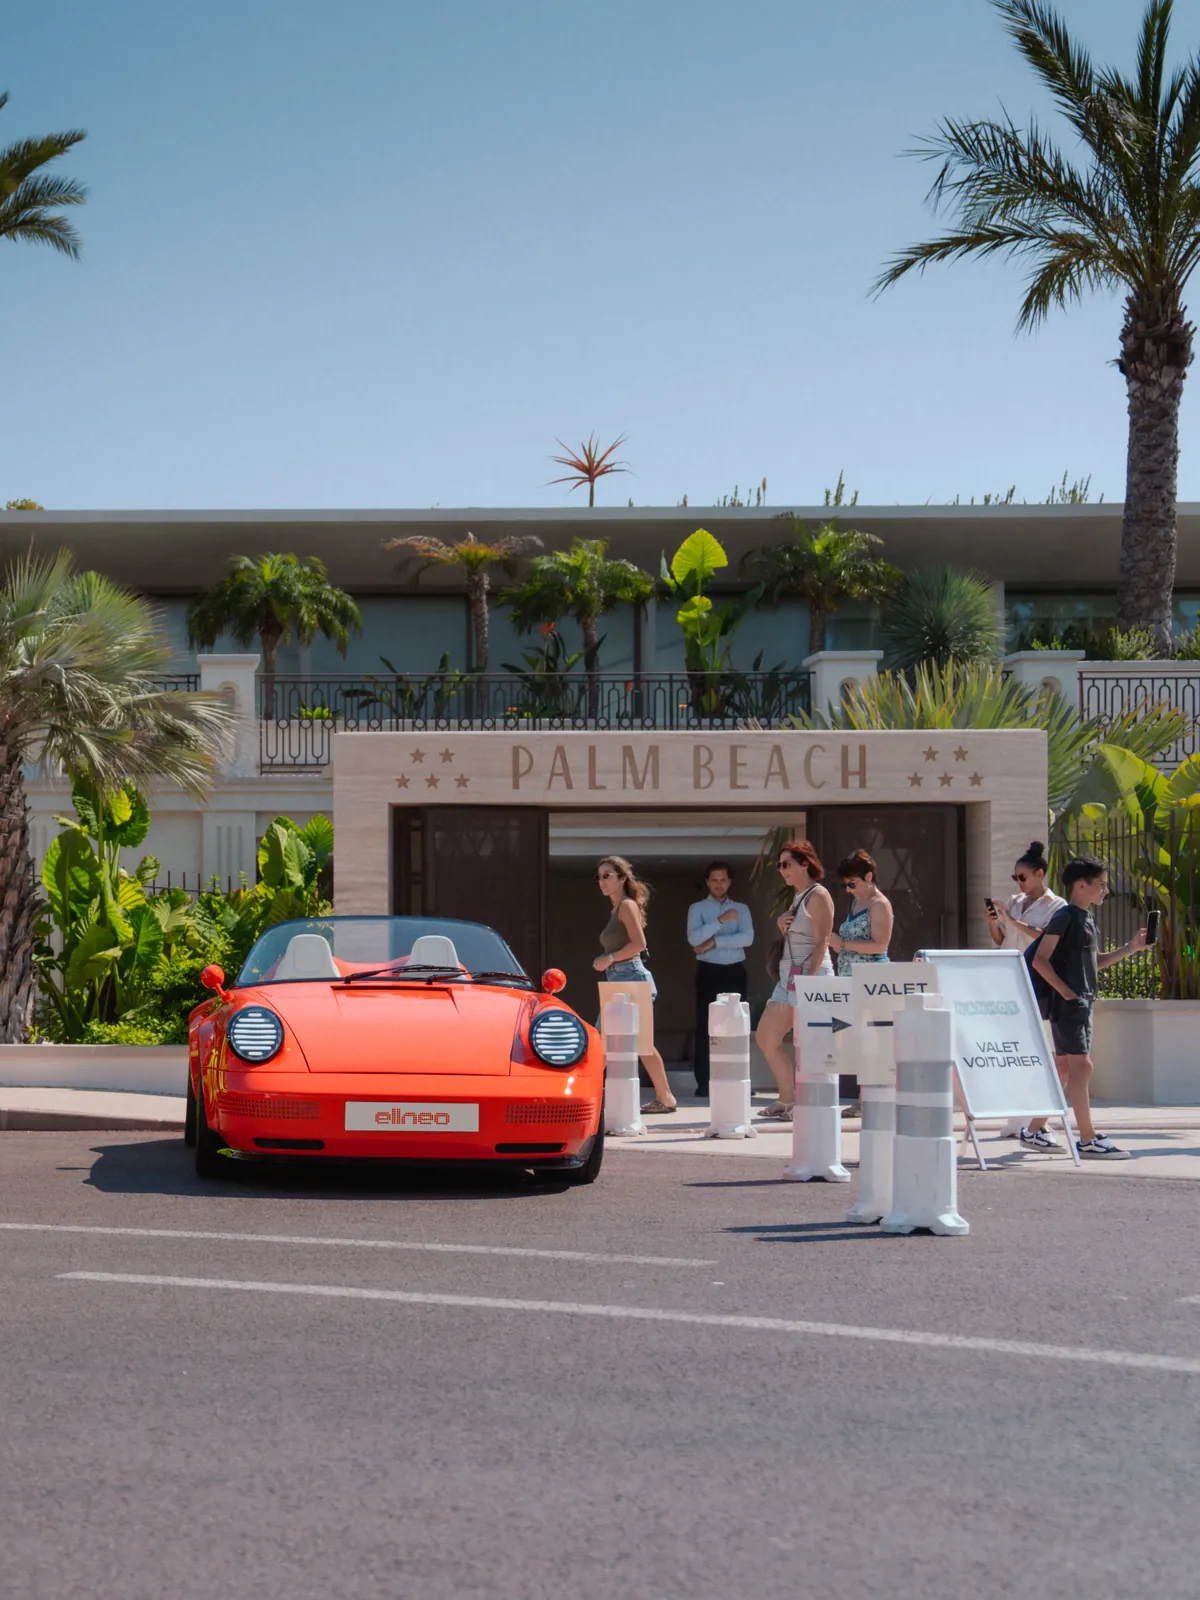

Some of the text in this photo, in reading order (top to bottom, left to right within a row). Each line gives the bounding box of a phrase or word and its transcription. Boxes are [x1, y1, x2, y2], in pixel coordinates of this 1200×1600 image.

[511, 743, 868, 790] PALM BEACH
[864, 983, 928, 996] VALET
[804, 992, 850, 1003] VALET
[975, 1041, 1019, 1053] VALET
[962, 1055, 1043, 1068] VOITURIER
[375, 1108, 450, 1125] ellneo
